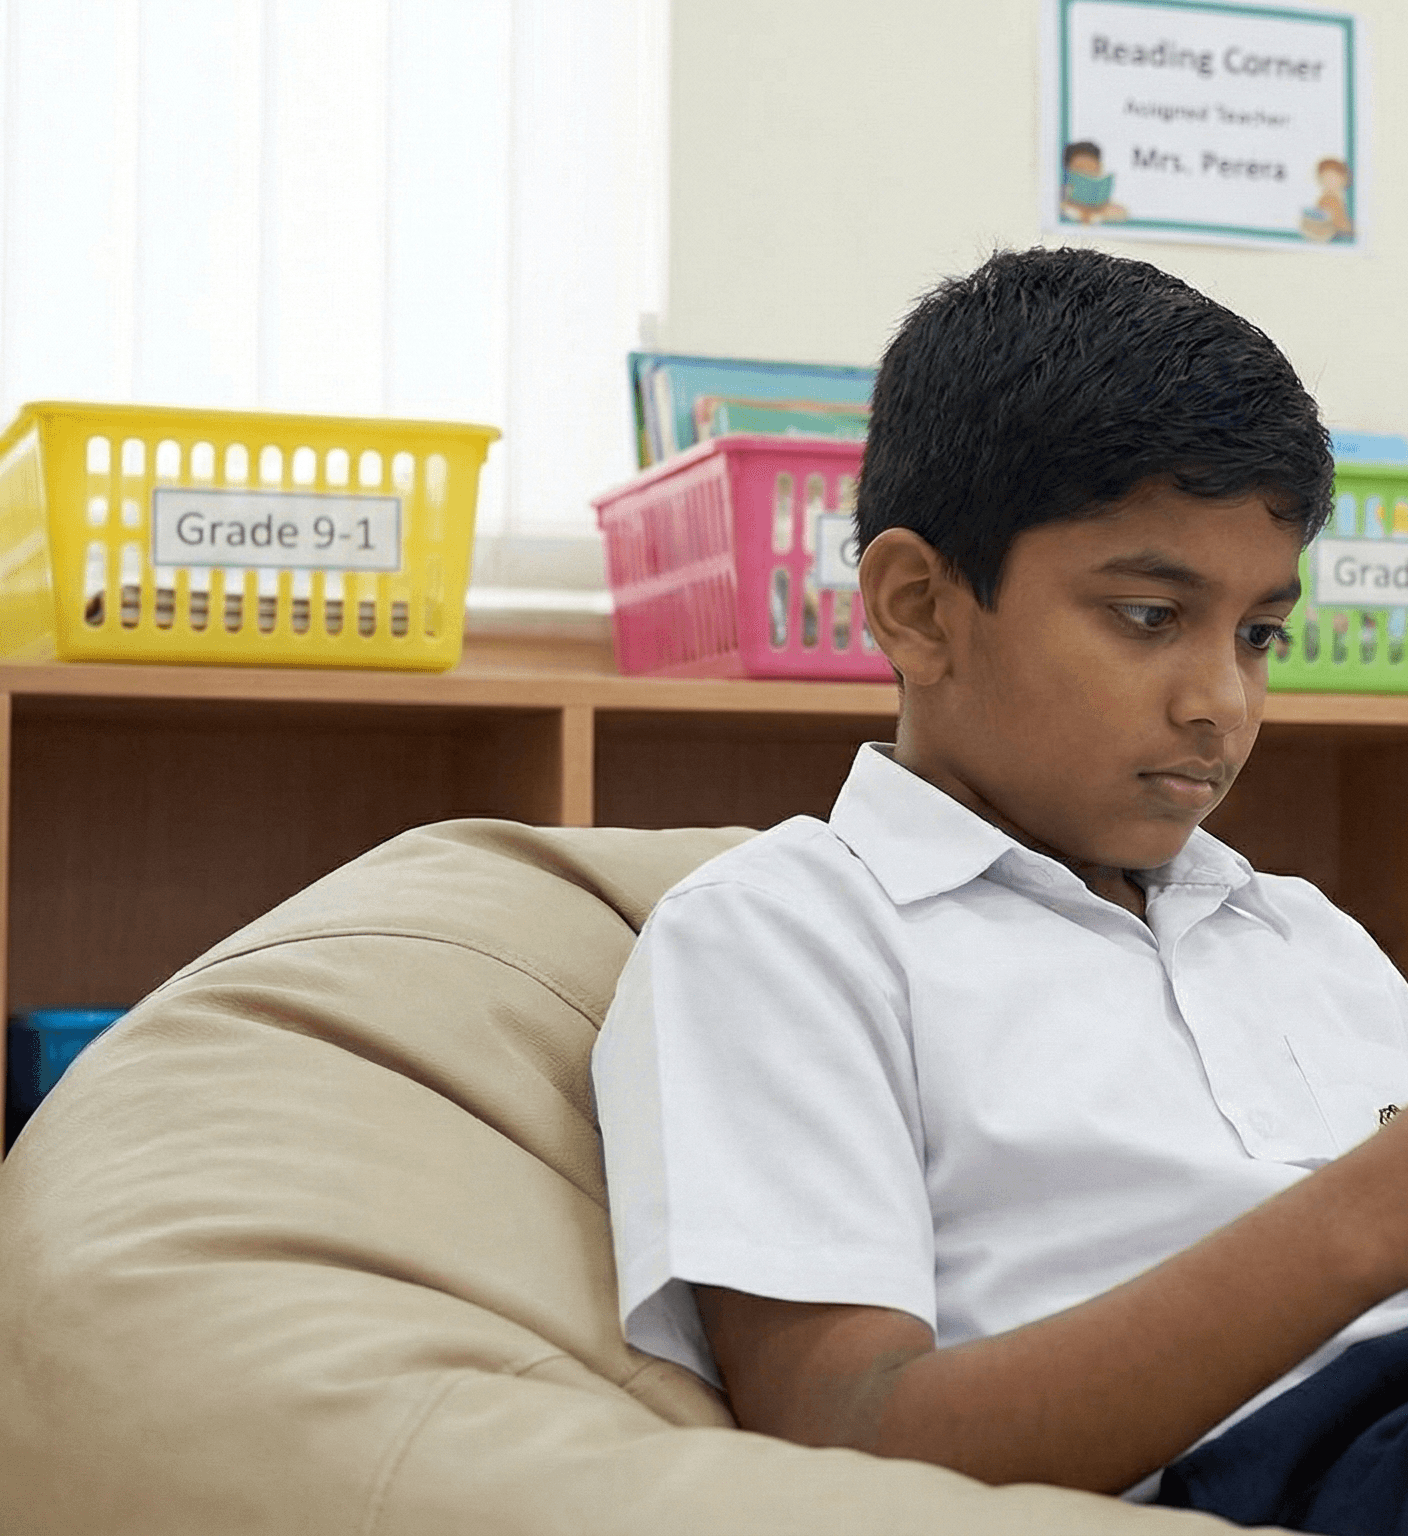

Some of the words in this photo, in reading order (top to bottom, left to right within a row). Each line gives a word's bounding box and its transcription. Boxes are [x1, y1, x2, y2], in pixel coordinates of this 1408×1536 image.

[1091, 34, 1214, 79] Reading
[1223, 47, 1323, 82] Corner
[1132, 147, 1192, 175] Mrs.
[1201, 150, 1286, 181] Perera
[176, 511, 299, 548] Grade
[313, 515, 375, 551] 9-1
